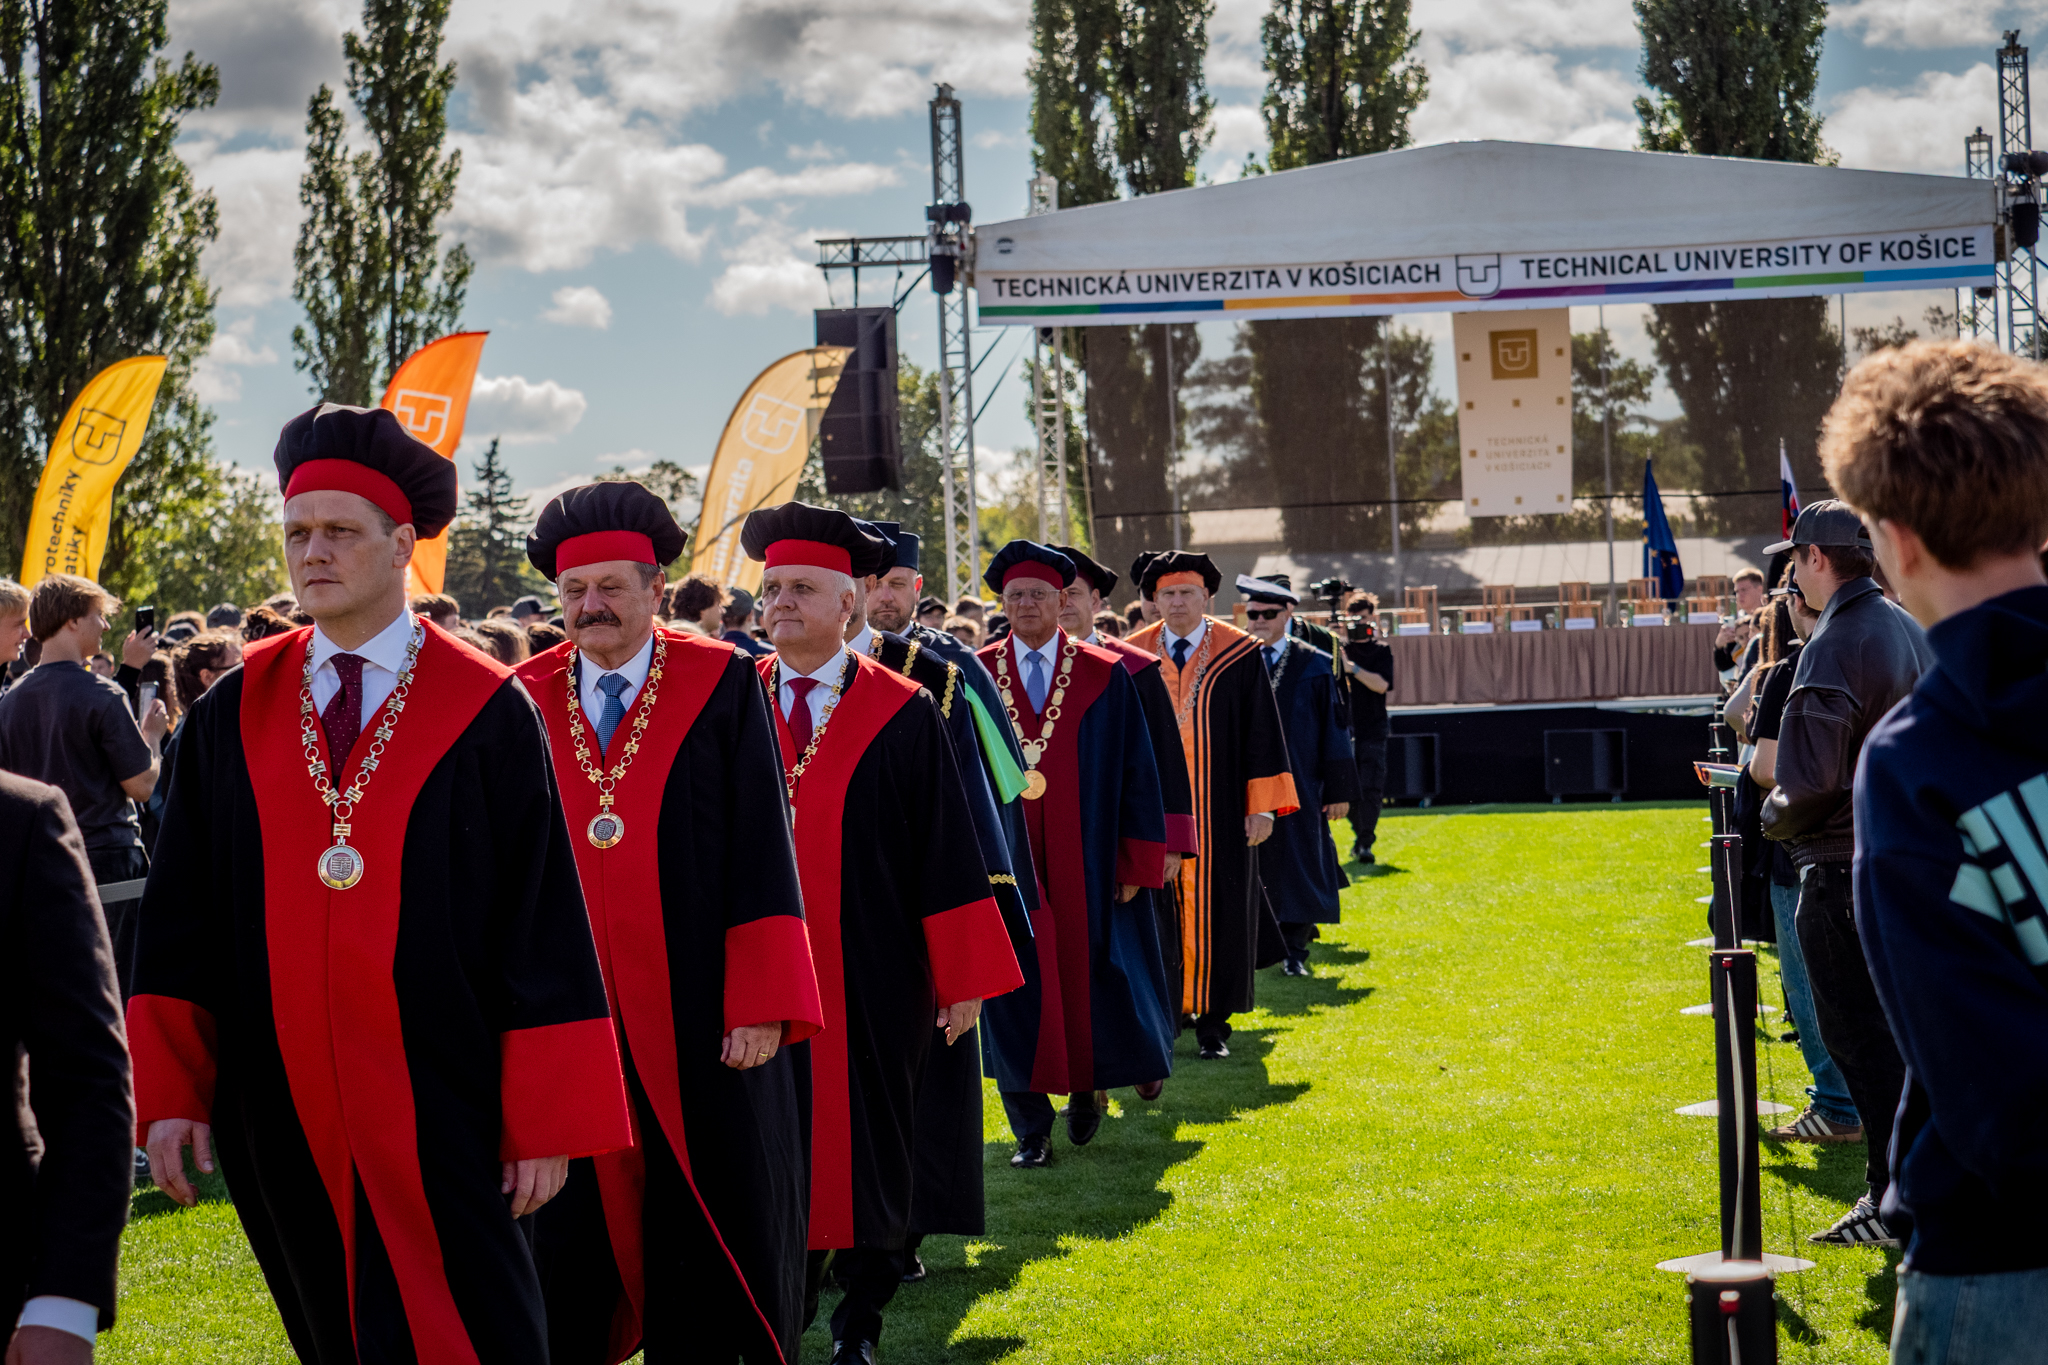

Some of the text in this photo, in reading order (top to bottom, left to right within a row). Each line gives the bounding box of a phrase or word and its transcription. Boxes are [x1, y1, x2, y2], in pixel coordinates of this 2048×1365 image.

[1520, 232, 1976, 280] TECHNICAL UNIVERSITY OF KOŠICE
[991, 260, 1441, 298] TECHNICKÁ UNIVERZITA V KOŠICIACH
[1486, 434, 1550, 446] TECHNICKÁ
[1485, 448, 1550, 460] UNIVERZITA
